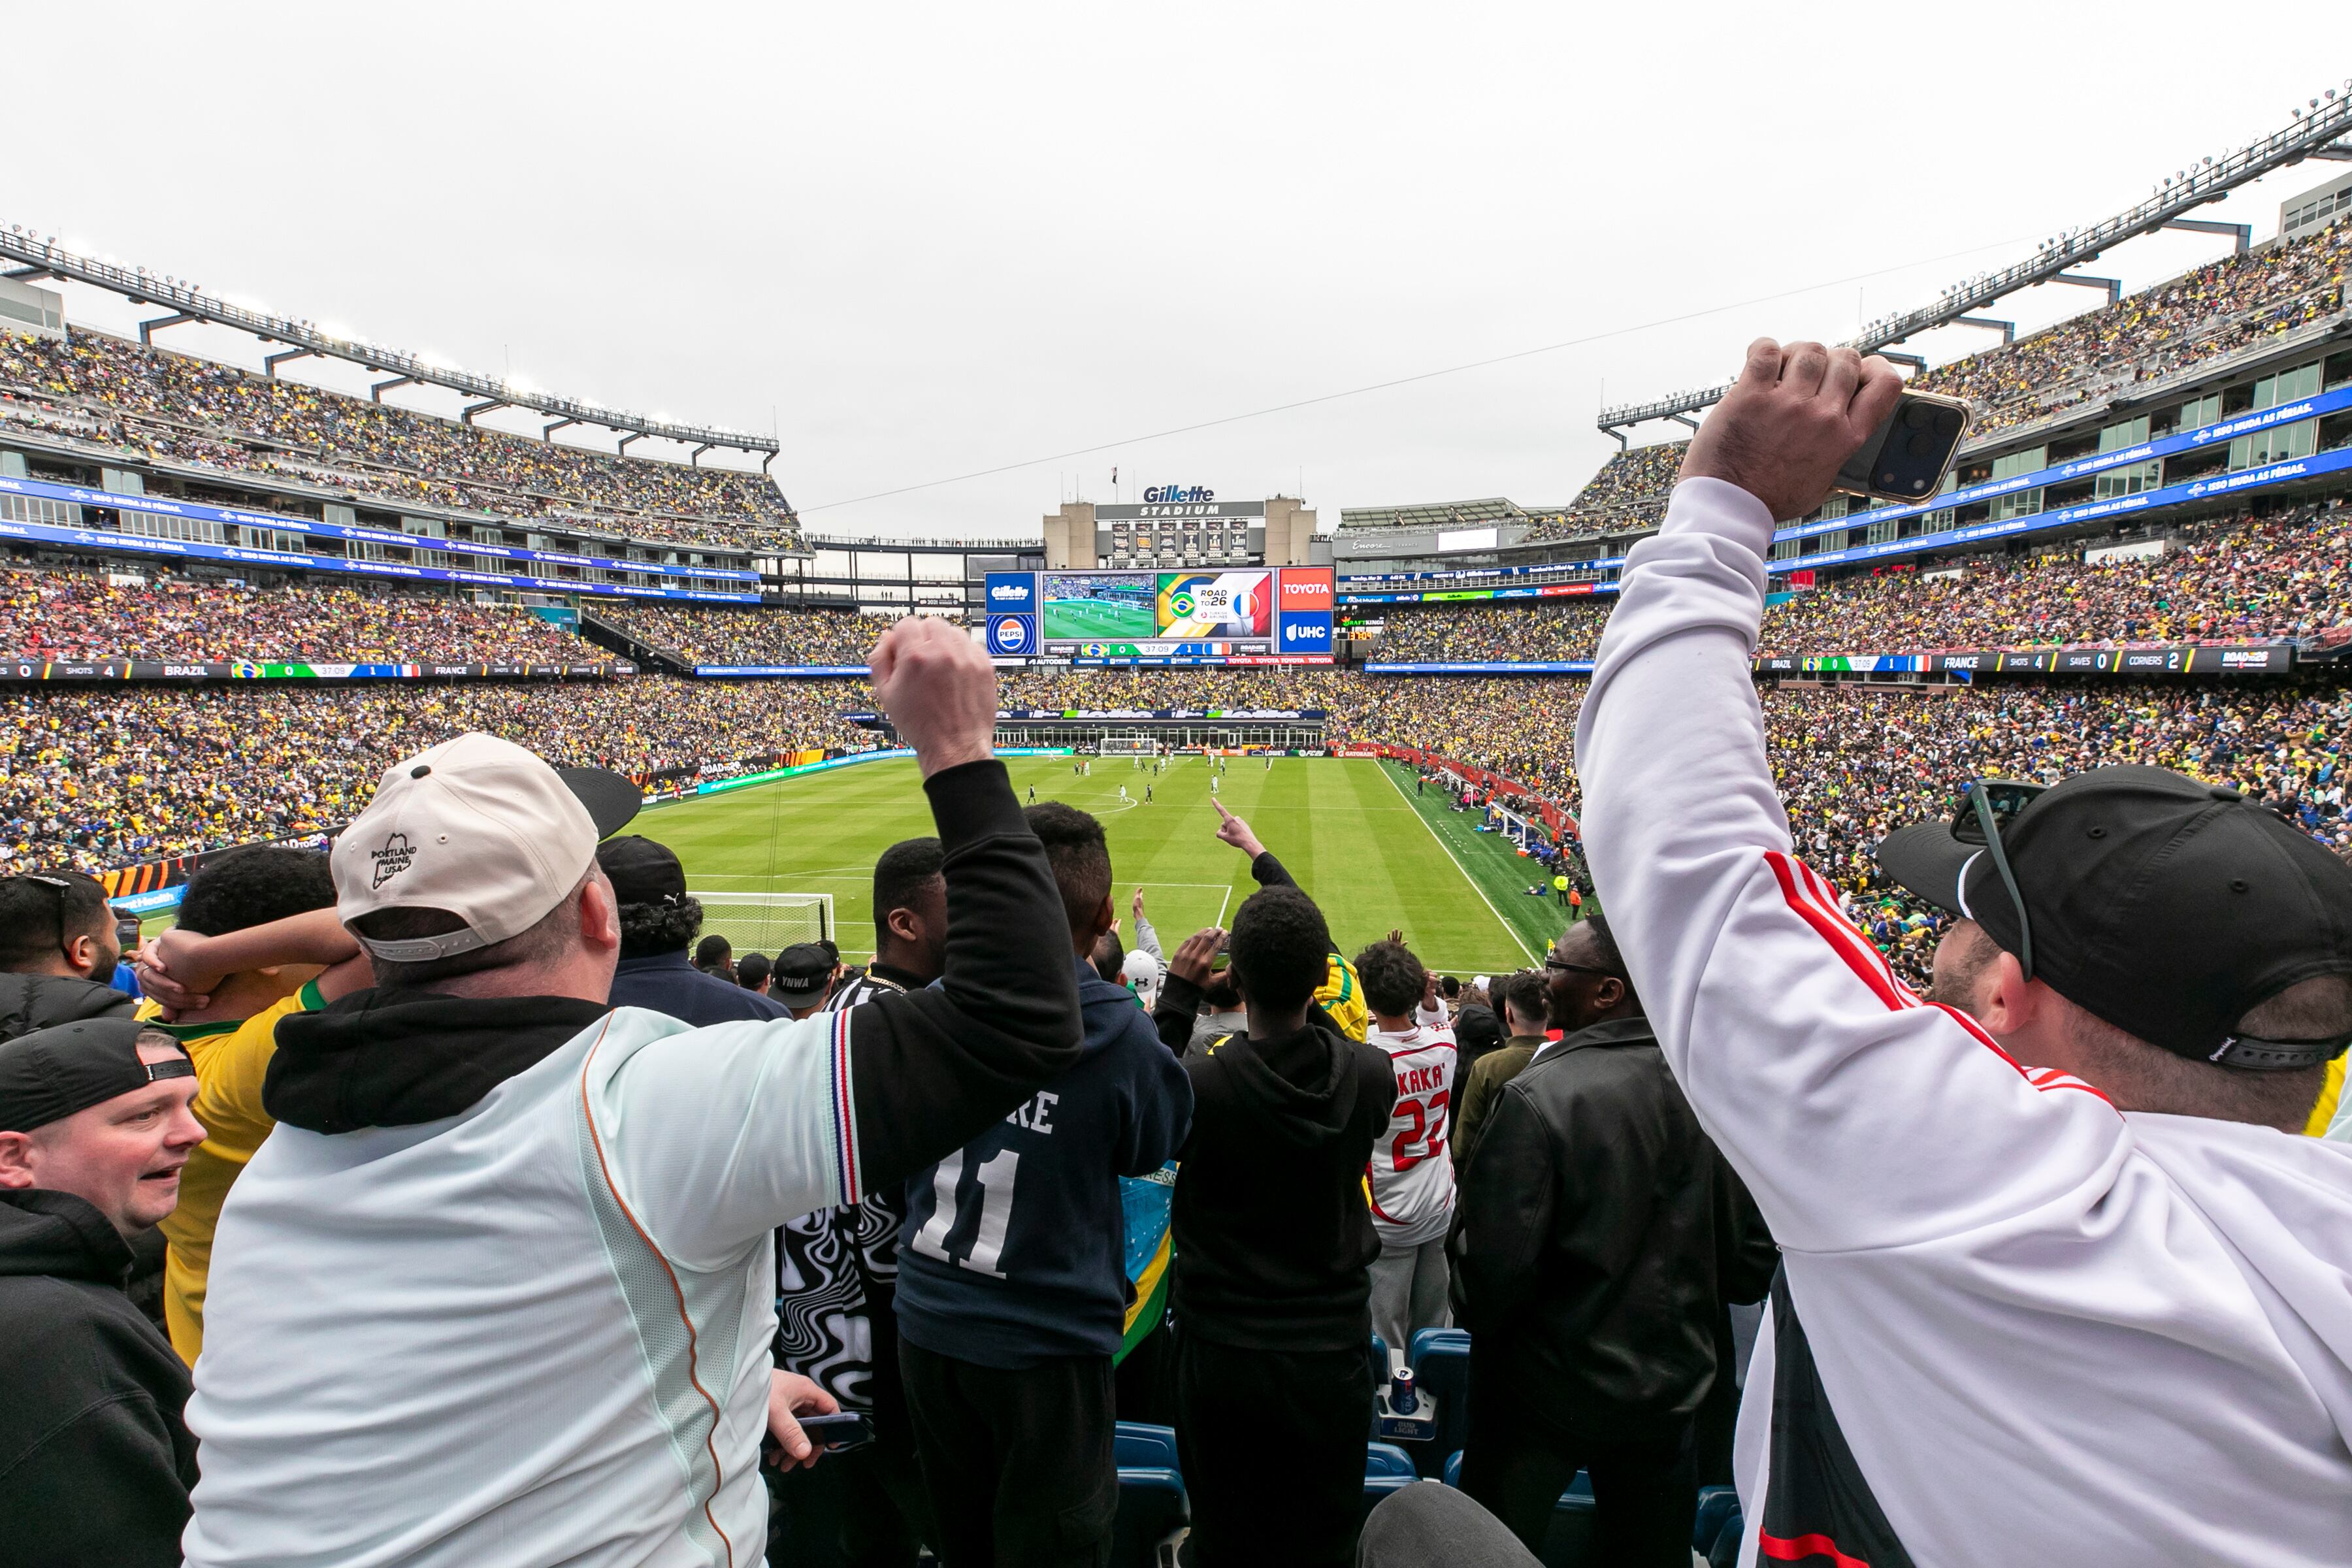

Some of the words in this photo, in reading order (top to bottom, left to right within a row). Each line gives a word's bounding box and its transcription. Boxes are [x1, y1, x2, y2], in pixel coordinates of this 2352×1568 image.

[2213, 424, 2233, 438] ISSO
[2234, 417, 2262, 433] MUDA
[2262, 412, 2276, 425] AS
[2208, 480, 2228, 492] ISSO
[2229, 474, 2255, 488] MUDA
[2255, 470, 2269, 482] AS
[1144, 485, 1215, 503] Gillette
[1140, 505, 1219, 515] STADIUM
[1352, 540, 1390, 549] Encore
[992, 585, 1028, 598] Gillette
[1283, 583, 1330, 594] TOYOTA
[1211, 597, 1227, 606] 26
[1298, 626, 1326, 638] UHC
[1350, 632, 1373, 640] 37:09
[1772, 659, 1791, 668] BRAZIL
[1833, 659, 1838, 668] 0
[1889, 659, 1894, 668] 1
[1944, 657, 1978, 668] FRANCE
[2034, 655, 2042, 669] 4
[2070, 657, 2090, 666] SAVES
[2097, 653, 2106, 669] 0
[2129, 656, 2163, 666] CORNERS
[2167, 653, 2179, 669] 2
[19, 665, 31, 677] 0
[104, 666, 114, 677] 4
[164, 666, 208, 676] BRAZIL
[284, 666, 293, 676] 0
[370, 666, 376, 675] 1
[372, 847, 417, 859] PORTLAND
[381, 856, 409, 866] MAINE
[385, 865, 402, 874] USA
[783, 976, 809, 987] YNWA
[1392, 1088, 1450, 1172] 22
[912, 1147, 1019, 1279] 11
[1394, 1426, 1419, 1435] LIGHT
